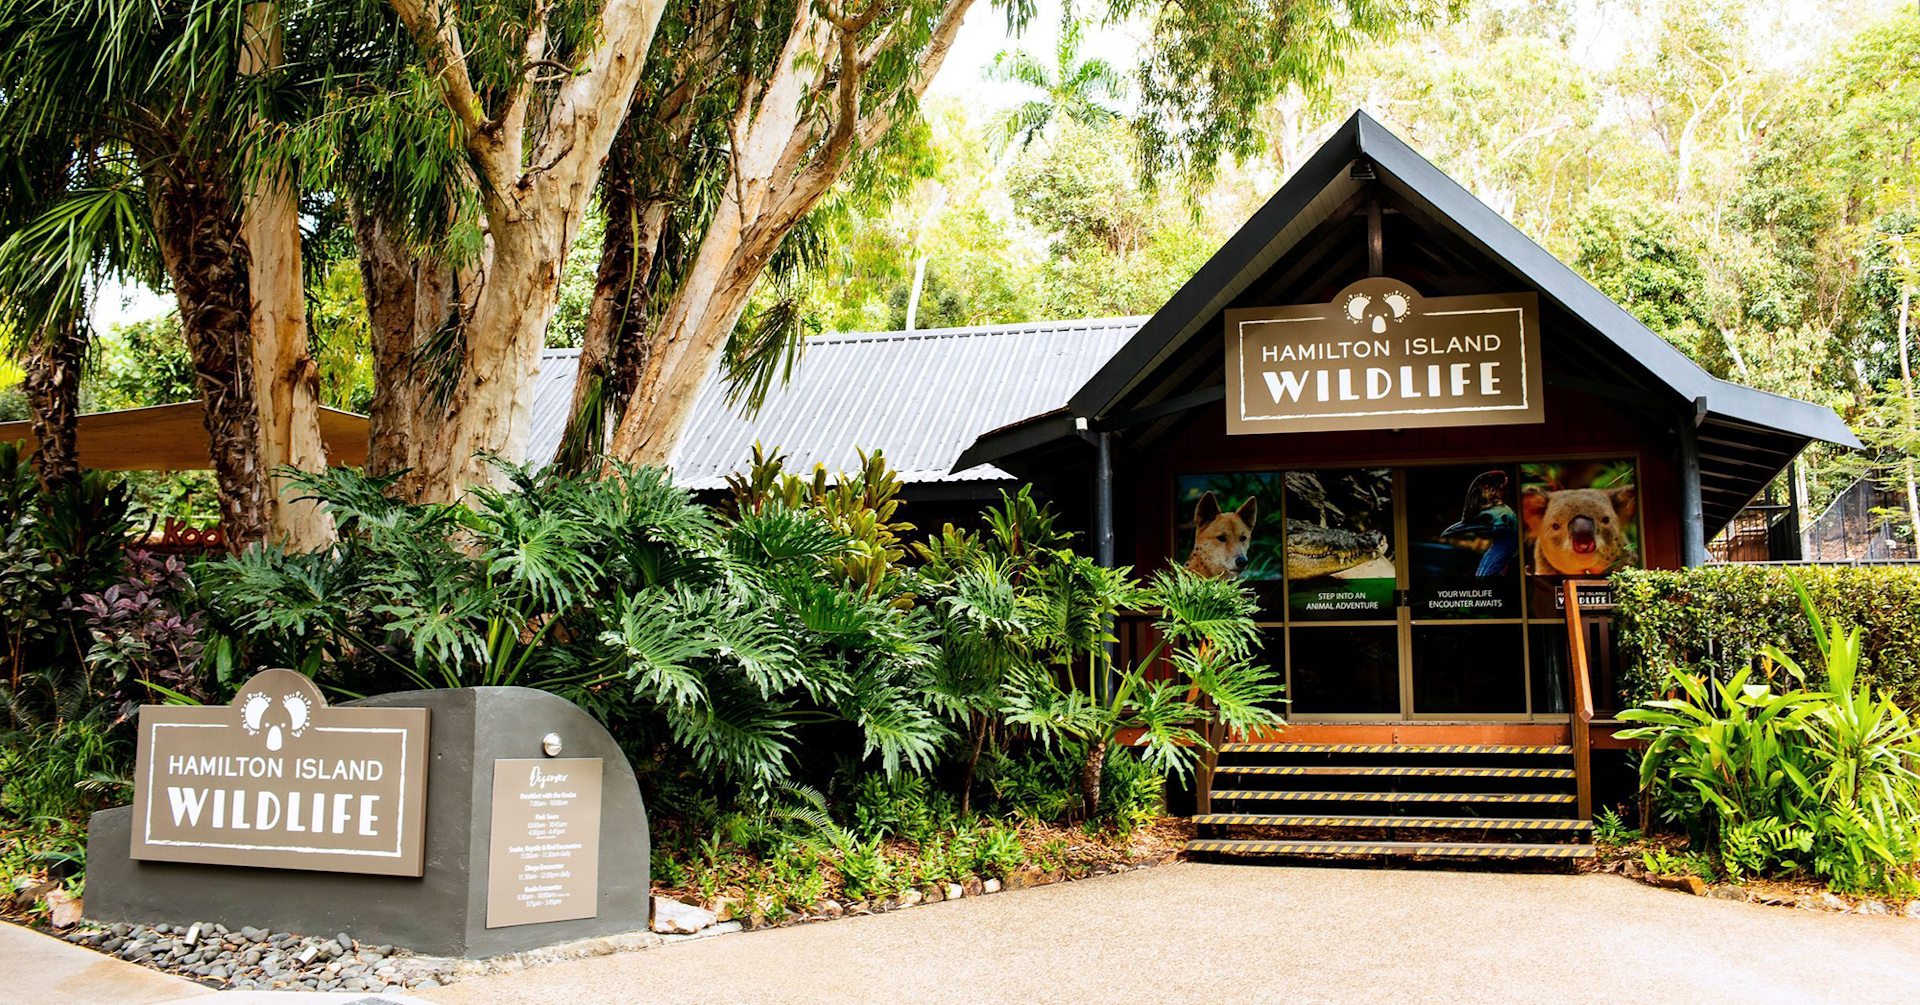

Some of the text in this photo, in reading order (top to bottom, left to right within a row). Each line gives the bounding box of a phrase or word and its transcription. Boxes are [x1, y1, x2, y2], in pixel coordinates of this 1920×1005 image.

[1262, 334, 1501, 362] HAMILTON ISLAND
[1262, 362, 1501, 404] WILDLIFE
[1306, 601, 1379, 610] ANIMAL ADVENTURE
[1318, 592, 1335, 600] STEP
[1428, 599, 1502, 608] ENCOUNTER AWAITS
[1558, 596, 1607, 604] WDLIFE
[169, 755, 383, 781] HAMILTON ISLAND
[530, 766, 568, 788] Discover
[167, 787, 380, 836] WILDLIFE
